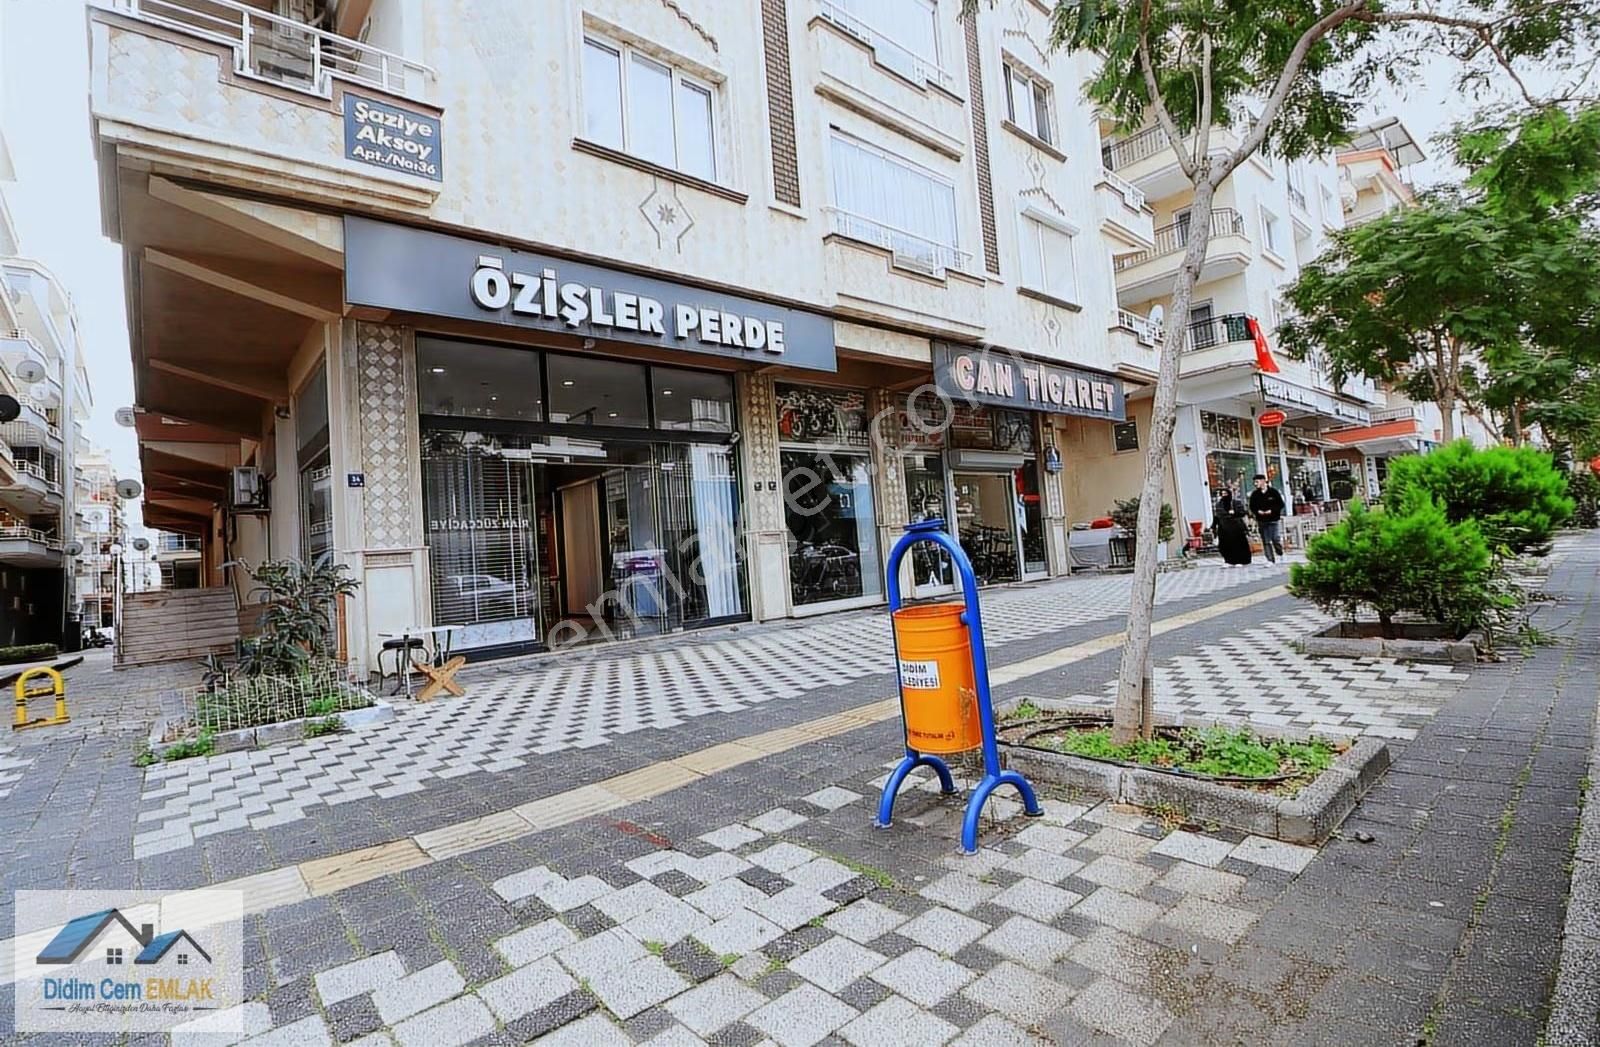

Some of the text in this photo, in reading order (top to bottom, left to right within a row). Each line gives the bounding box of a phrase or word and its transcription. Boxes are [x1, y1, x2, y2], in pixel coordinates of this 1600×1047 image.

[356, 124, 432, 160] Aksoy
[674, 302, 785, 354] PERDE
[954, 354, 1115, 412] CAN TİCARET
